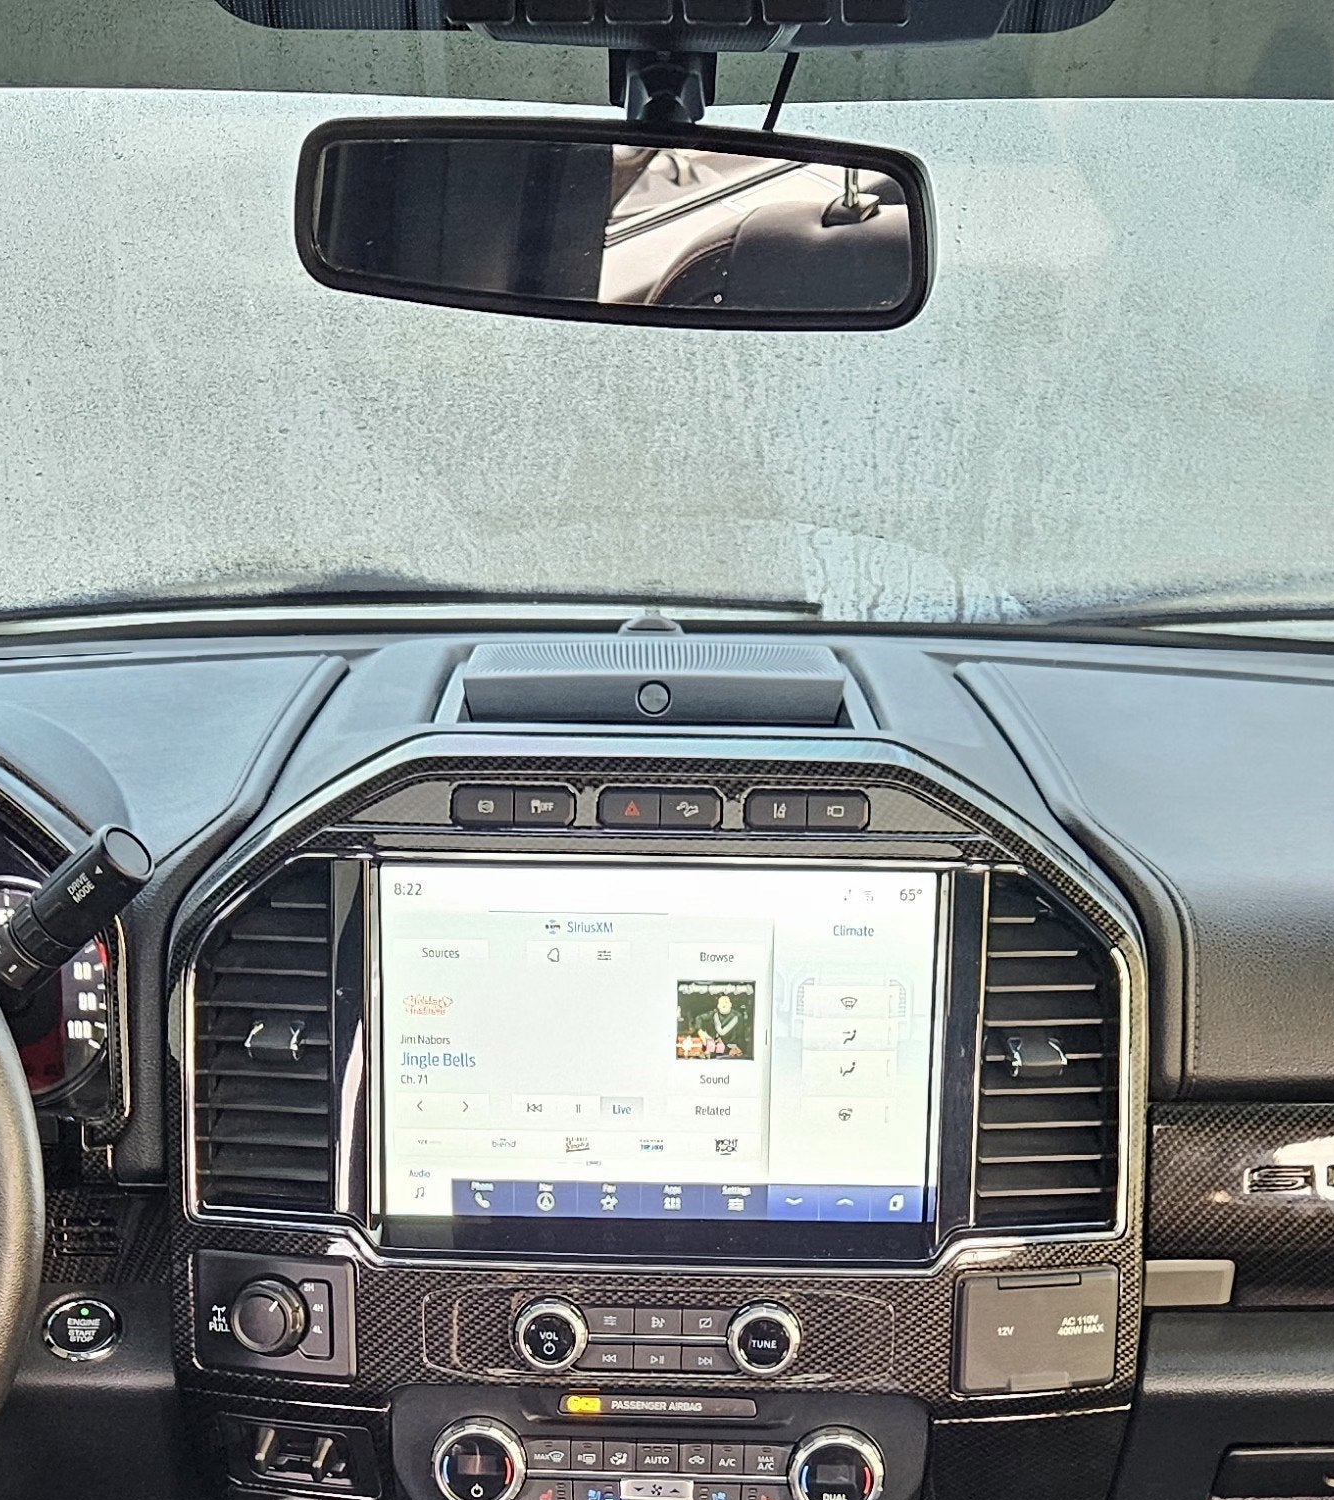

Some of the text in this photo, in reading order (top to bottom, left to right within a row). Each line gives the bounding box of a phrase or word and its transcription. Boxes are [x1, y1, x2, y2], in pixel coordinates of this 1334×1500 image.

[67, 872, 89, 895] DRIVE
[72, 883, 96, 904] MODE
[393, 883, 422, 896] 8:22
[567, 921, 614, 934] SiriusXM
[833, 925, 874, 938] Climate
[422, 947, 460, 959] Sources
[700, 952, 734, 963] Browse
[400, 1034, 451, 1045] Jim Nabors
[401, 1052, 476, 1070] Jingle Bells
[418, 1074, 428, 1085] 71
[700, 1075, 730, 1085] Sound
[612, 1103, 632, 1116] Live
[695, 1105, 731, 1117] Related
[313, 1304, 324, 1313] 4H
[67, 1318, 101, 1326] ENGINE
[208, 1321, 231, 1333] PULL
[1061, 1315, 1100, 1328] AC 110V
[997, 1326, 1015, 1337] 12V
[1057, 1323, 1105, 1336] 400W MAX
[539, 1331, 559, 1341] VOL
[751, 1339, 777, 1349] TUNE
[611, 1400, 703, 1412] PASSENGER AIRBAG
[533, 1452, 550, 1461] MAX
[644, 1455, 670, 1465] AUTO
[757, 1455, 775, 1463] MAX
[718, 1458, 736, 1468] A/C
[757, 1462, 775, 1471] A/C
